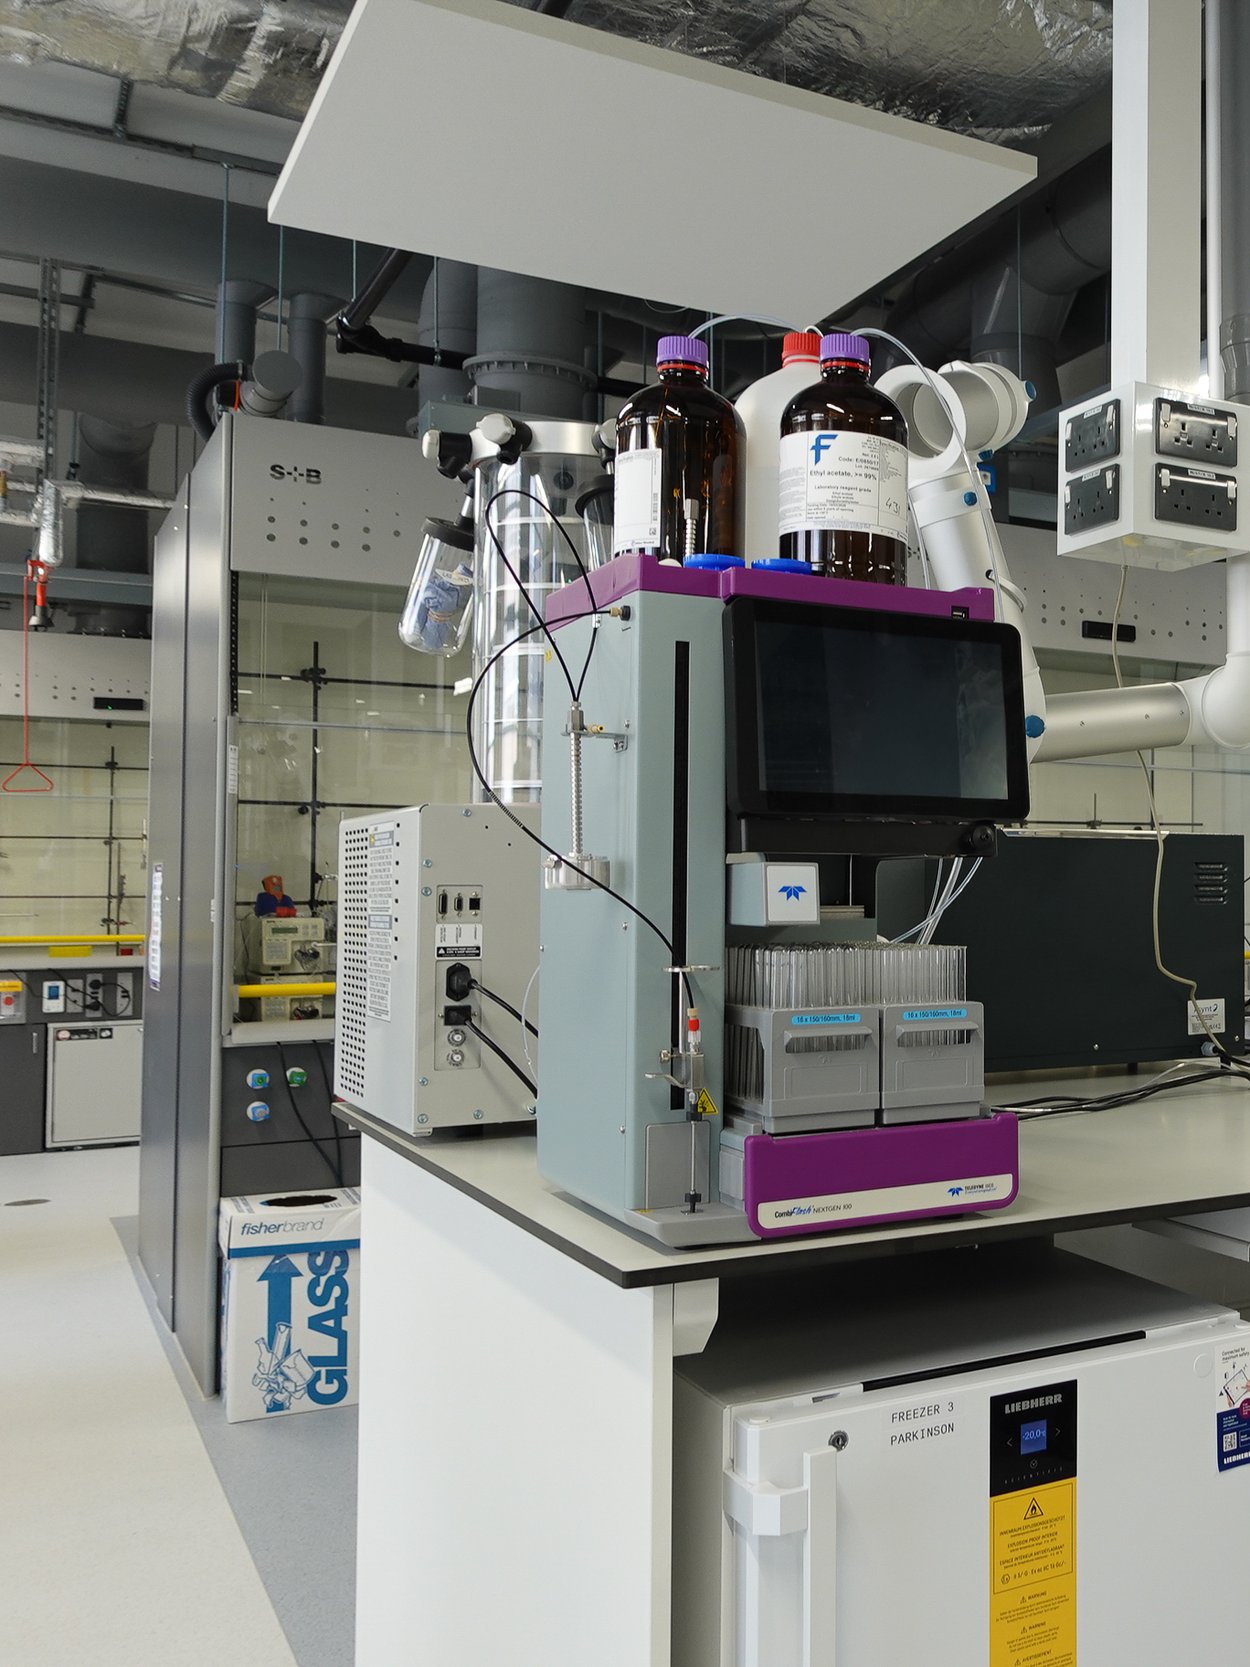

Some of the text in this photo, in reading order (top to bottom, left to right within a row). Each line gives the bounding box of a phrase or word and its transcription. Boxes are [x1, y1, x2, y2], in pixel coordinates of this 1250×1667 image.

[269, 464, 322, 484] S+B
[827, 470, 853, 478] acetate,
[813, 1206, 841, 1214] NEXTGEN
[240, 1218, 324, 1236] fisherbrand
[306, 1250, 350, 1406] GLASS
[1222, 1348, 1240, 1356] Connected
[891, 1401, 954, 1424] FREEZER 3
[1004, 1394, 1062, 1414] LIEBHERR
[890, 1422, 954, 1446] PARKINSON
[1008, 1539, 1028, 1548] EXPLOSION
